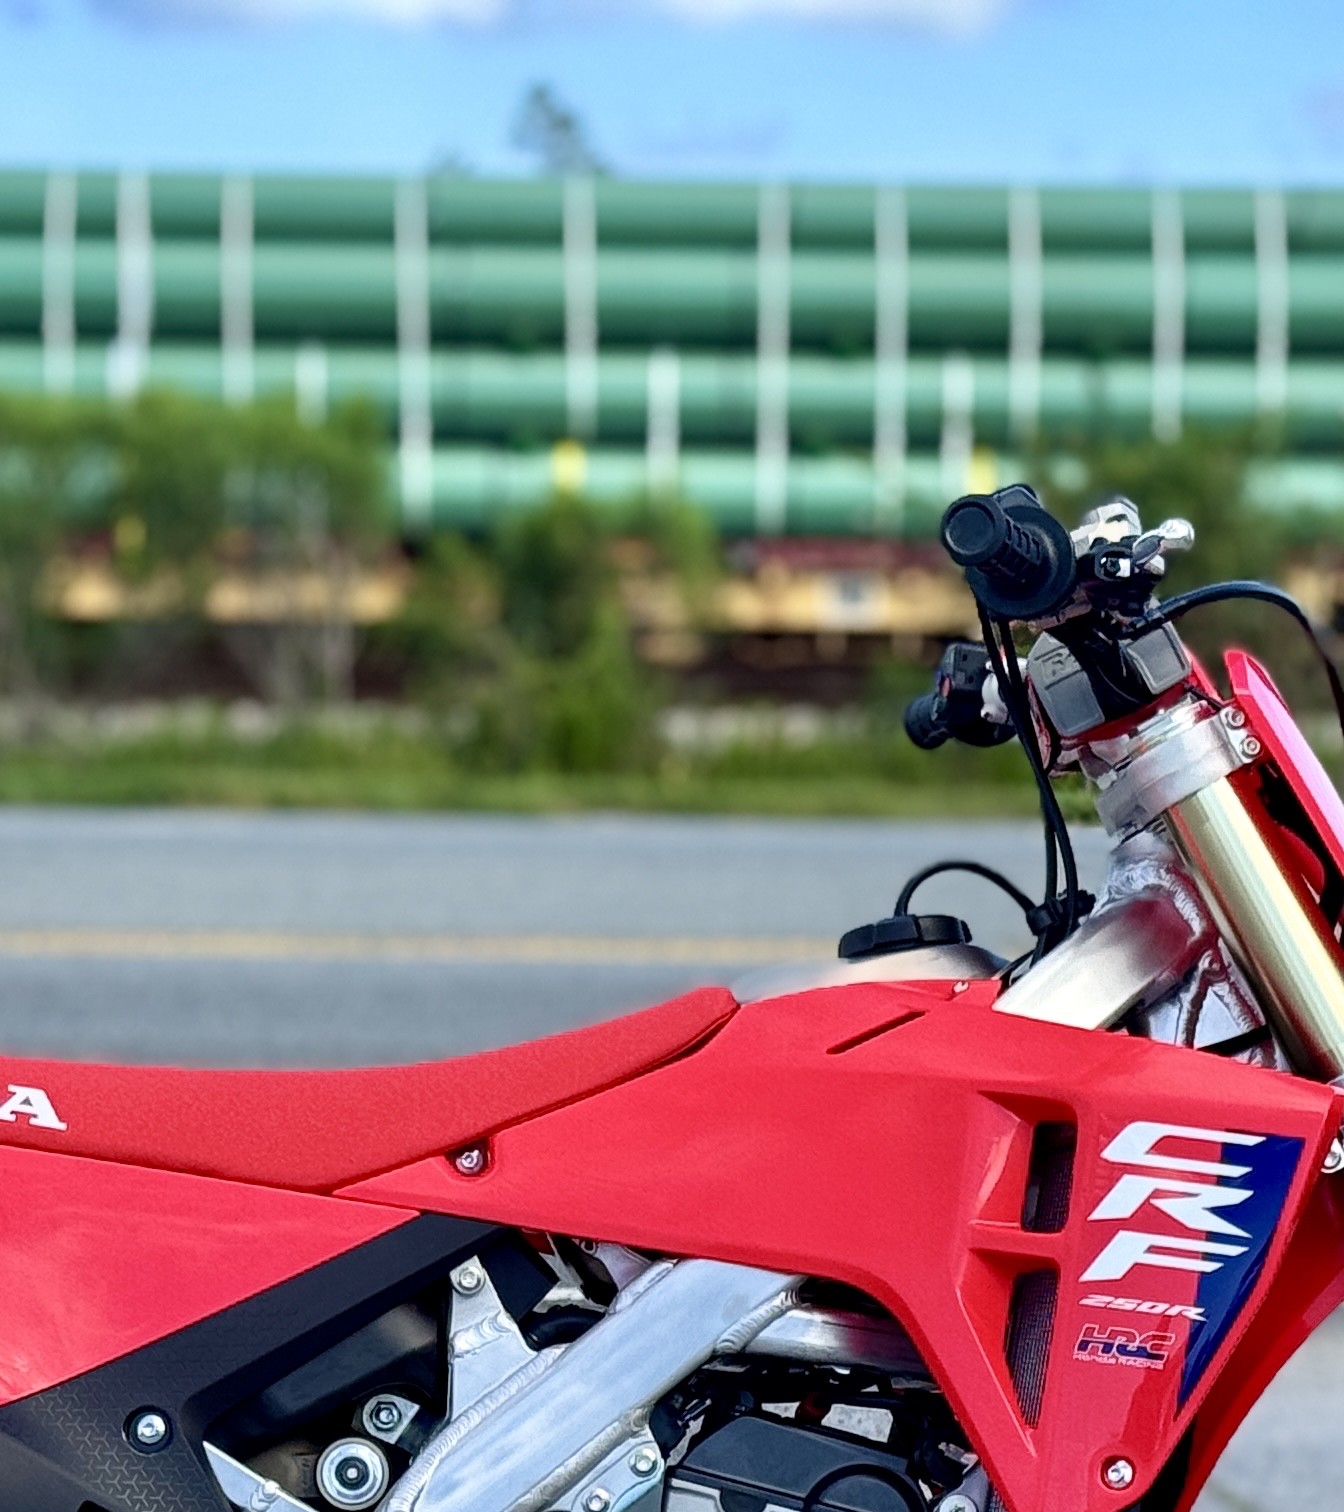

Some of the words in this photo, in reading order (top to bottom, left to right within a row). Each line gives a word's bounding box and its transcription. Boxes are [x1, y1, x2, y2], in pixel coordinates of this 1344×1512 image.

[1078, 1120, 1267, 1282] CRF
[1078, 1294, 1209, 1322] 250R
[1074, 1323, 1176, 1363] HRC
[1117, 1357, 1164, 1370] RACING
